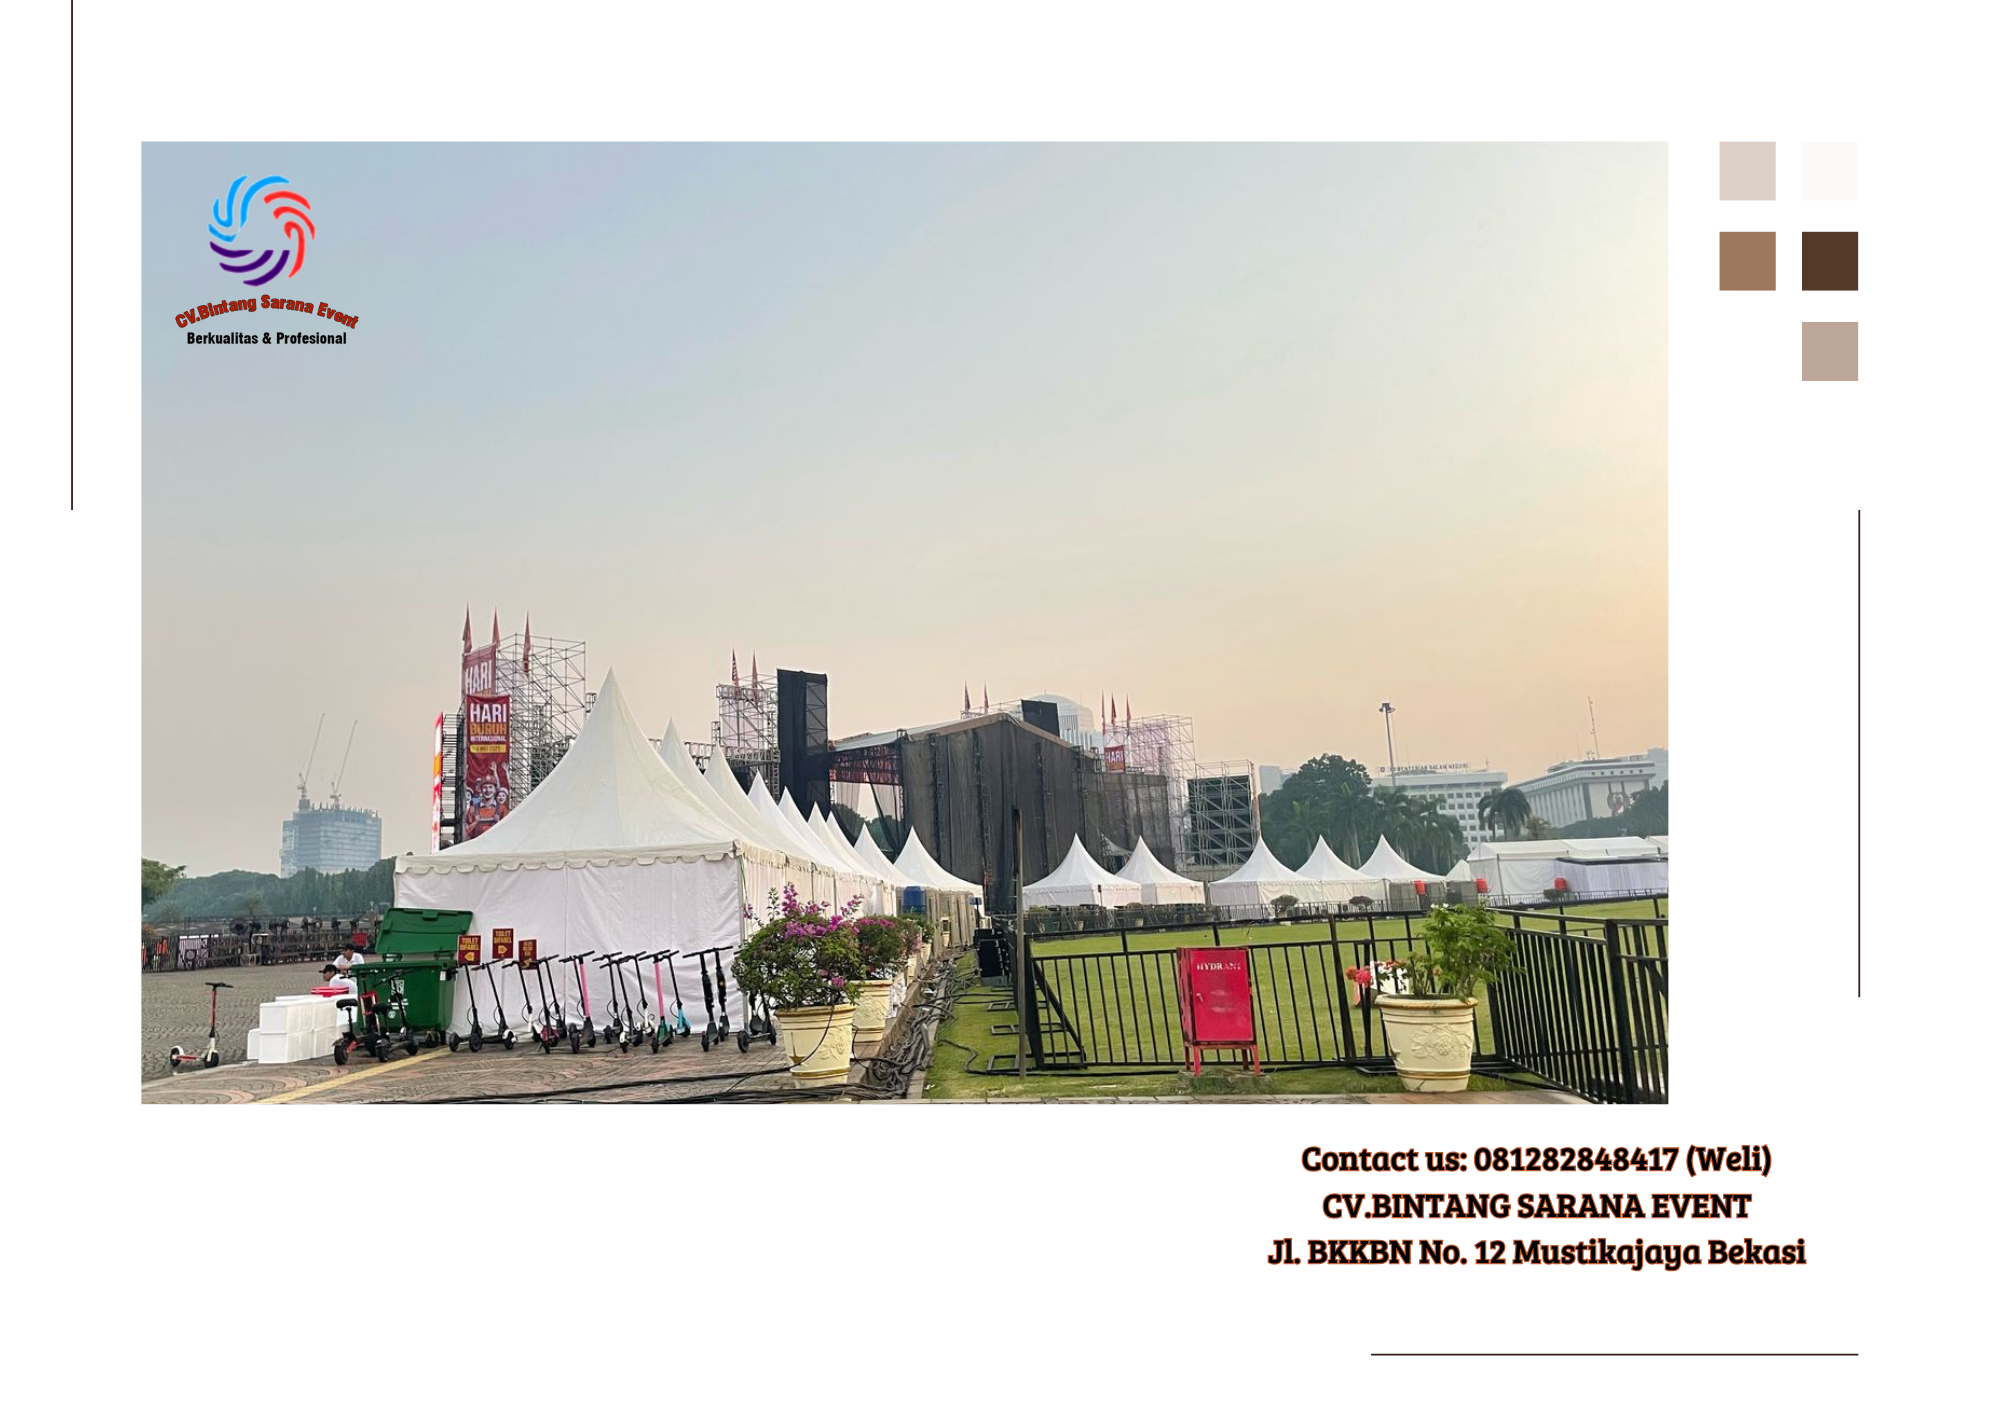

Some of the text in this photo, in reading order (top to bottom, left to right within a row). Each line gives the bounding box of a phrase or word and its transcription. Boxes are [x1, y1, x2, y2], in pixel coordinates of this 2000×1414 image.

[465, 660, 492, 696] HARI
[470, 703, 507, 723] HARI
[470, 723, 507, 736] BURUH
